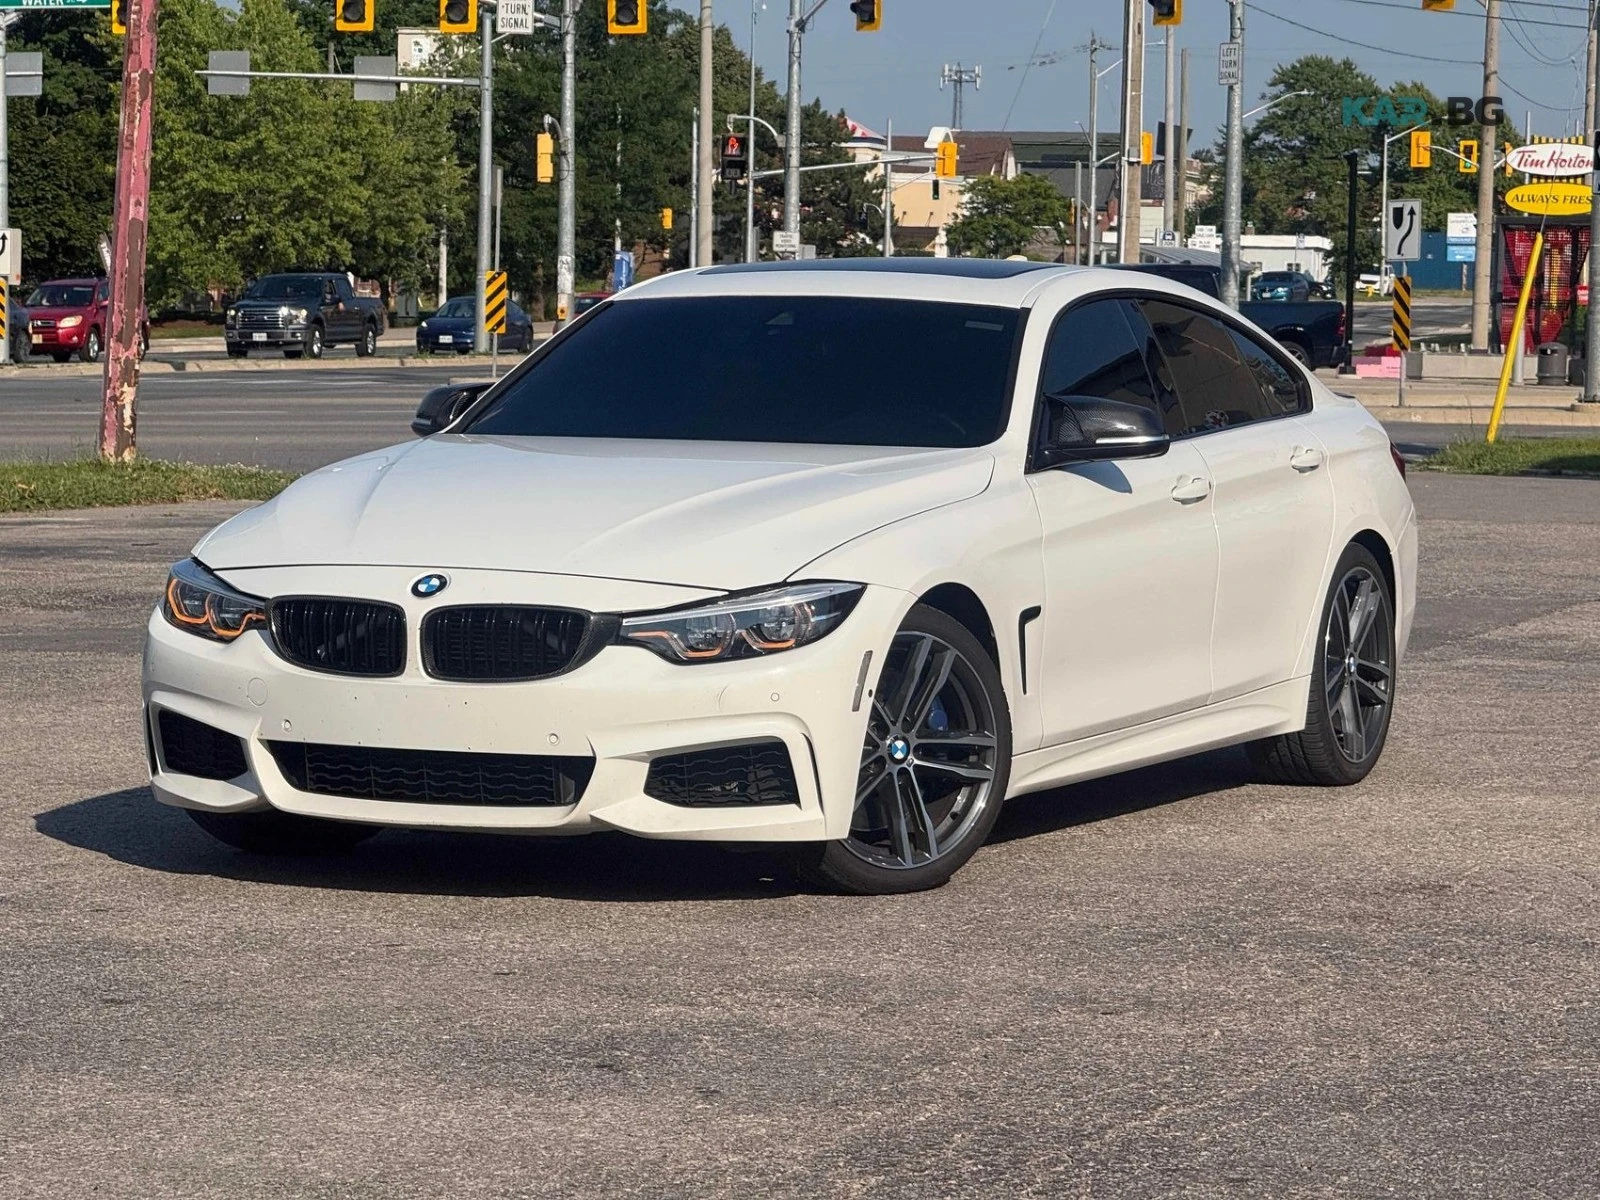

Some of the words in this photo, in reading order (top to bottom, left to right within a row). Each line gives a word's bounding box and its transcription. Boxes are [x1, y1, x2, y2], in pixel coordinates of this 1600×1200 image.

[500, 17, 529, 29] SIGNAL
[1222, 47, 1237, 57] LEFT
[1221, 60, 1237, 69] TURN
[1516, 150, 1545, 169] Tim
[1547, 150, 1593, 169] Horton
[1511, 194, 1559, 204] ALWAYS
[1562, 195, 1593, 205] FRES
